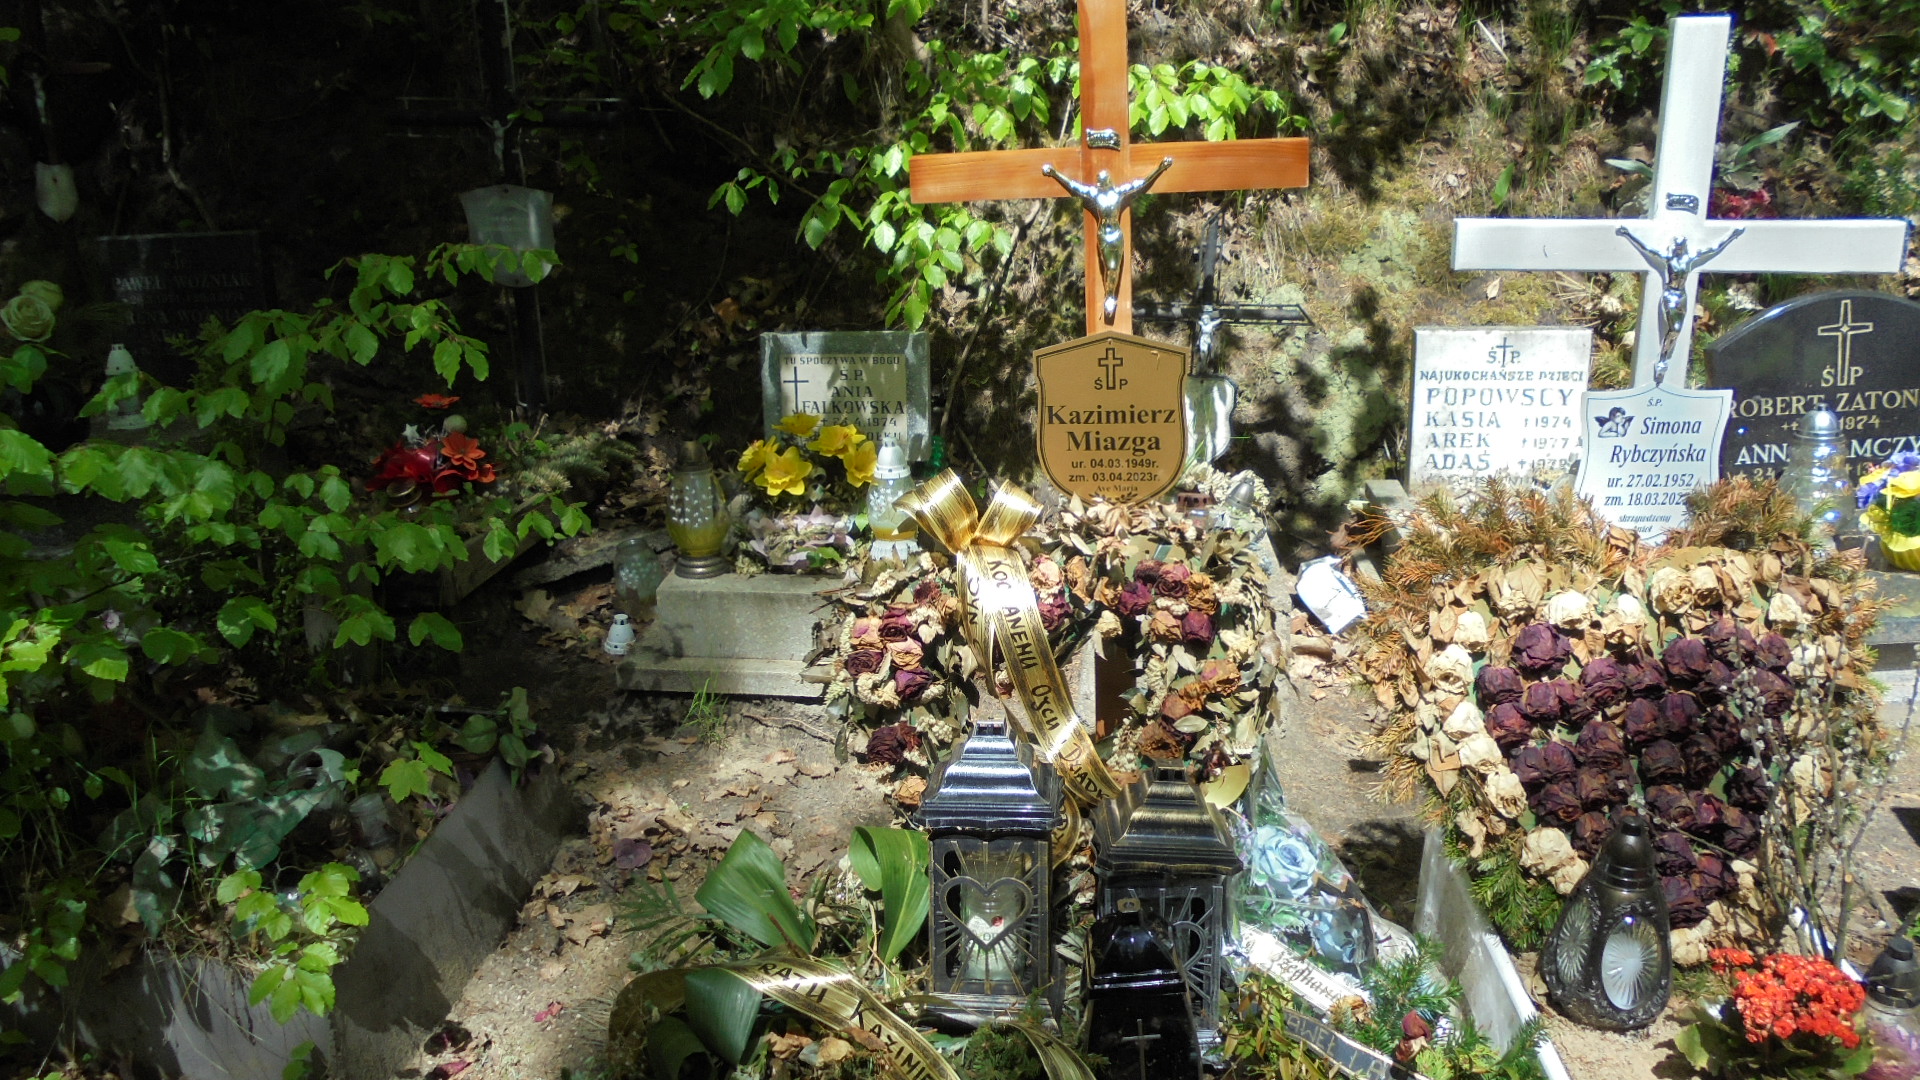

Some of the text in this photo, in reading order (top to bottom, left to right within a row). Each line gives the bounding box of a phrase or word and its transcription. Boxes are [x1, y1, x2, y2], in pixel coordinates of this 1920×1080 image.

[784, 356, 900, 365] TU SPOCZYWA W BOGU
[1119, 378, 1128, 390] P
[1538, 370, 1584, 382] DZIECI
[1850, 366, 1864, 386] P
[830, 386, 873, 398] ANIA
[1426, 386, 1575, 407] POPOWSCY
[801, 400, 905, 415] FALKOWSKA
[1045, 404, 1176, 425] Kazimierz
[1730, 394, 1825, 418] ROBERT
[1424, 411, 1571, 429] KASIA 1974
[1640, 416, 1702, 435] Simona
[1839, 415, 1881, 430] 1974
[1066, 431, 1161, 457] Miazga
[1425, 432, 1491, 449] AREK
[1071, 458, 1159, 469] ur. 04.03.1949r.
[1424, 450, 1491, 472] ADAŚ
[1609, 442, 1706, 468] Rybczyńska
[1734, 443, 1791, 466] ANN
[1068, 472, 1160, 482] zm. 03.04.2023r.
[1607, 473, 1694, 488] ur. 27.02.1952
[1604, 492, 1688, 506] zm. 18.03.202
[986, 559, 1039, 671] KOCANEMU
[758, 962, 828, 1004] RATU
